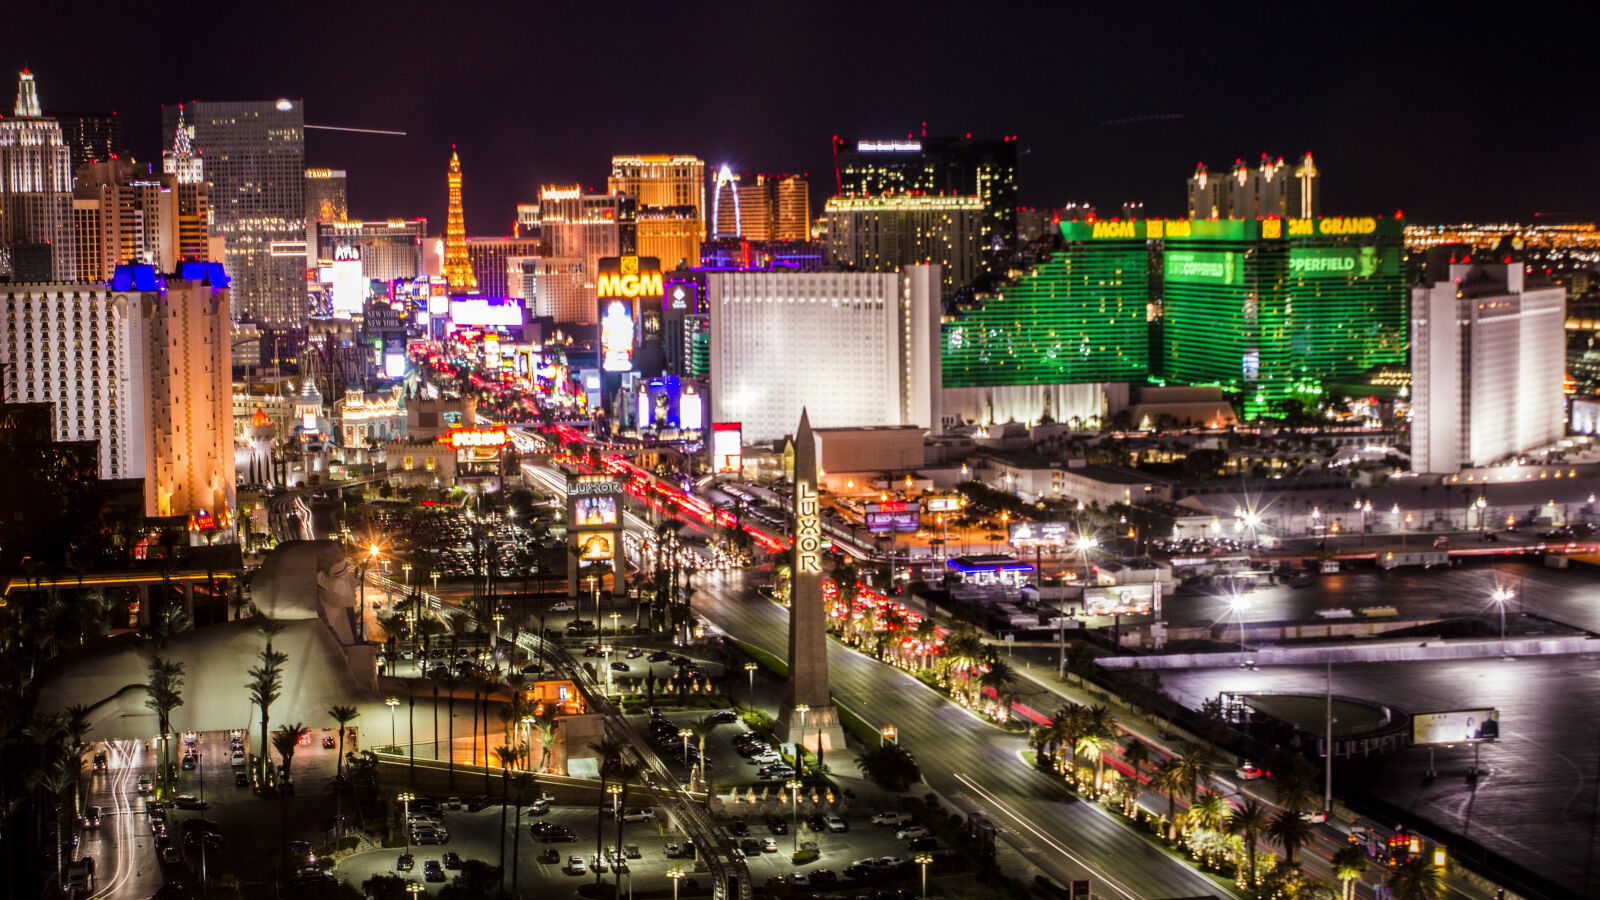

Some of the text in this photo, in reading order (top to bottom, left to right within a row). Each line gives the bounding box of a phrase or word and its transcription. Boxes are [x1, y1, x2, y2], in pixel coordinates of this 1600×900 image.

[308, 170, 332, 178] TRUMP
[542, 185, 581, 203] hollywood
[1092, 221, 1136, 238] MGM
[1319, 217, 1377, 235] GRAND
[1289, 258, 1355, 272] PPERFIELD
[598, 273, 664, 297] MGM
[367, 310, 399, 318] NEW YORK
[567, 481, 623, 496] LUXOR
[800, 483, 820, 572] LUXOR
